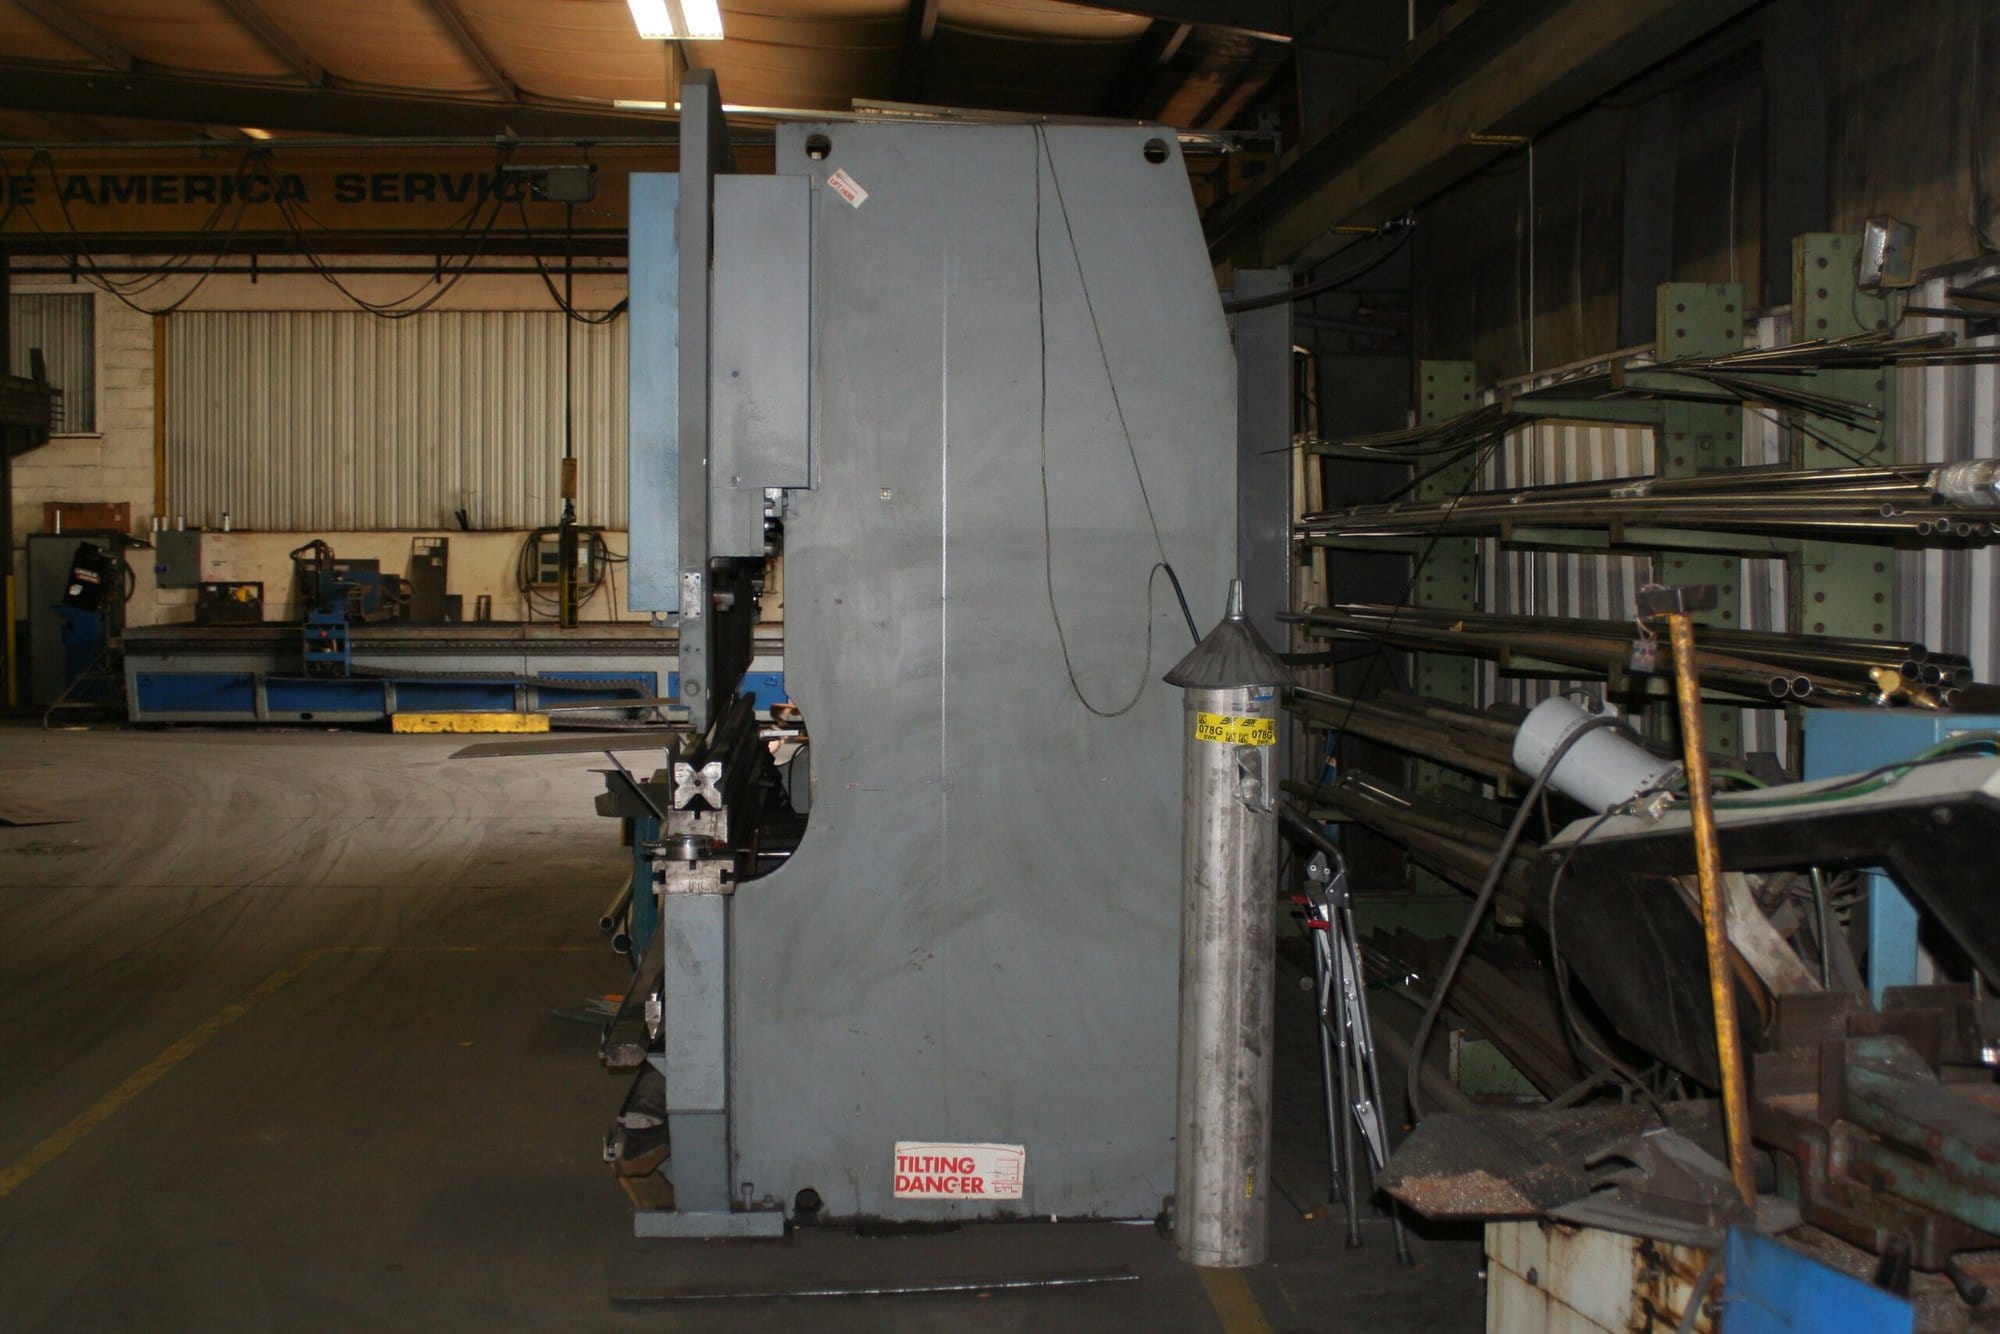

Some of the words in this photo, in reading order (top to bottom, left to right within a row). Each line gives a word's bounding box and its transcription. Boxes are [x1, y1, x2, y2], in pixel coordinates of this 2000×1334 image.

[63, 175, 308, 203] AMERICA
[1199, 725, 1223, 735] 078G
[1252, 730, 1273, 740] 078G
[897, 1156, 975, 1174] TILTING
[895, 1176, 984, 1193] DANGER
